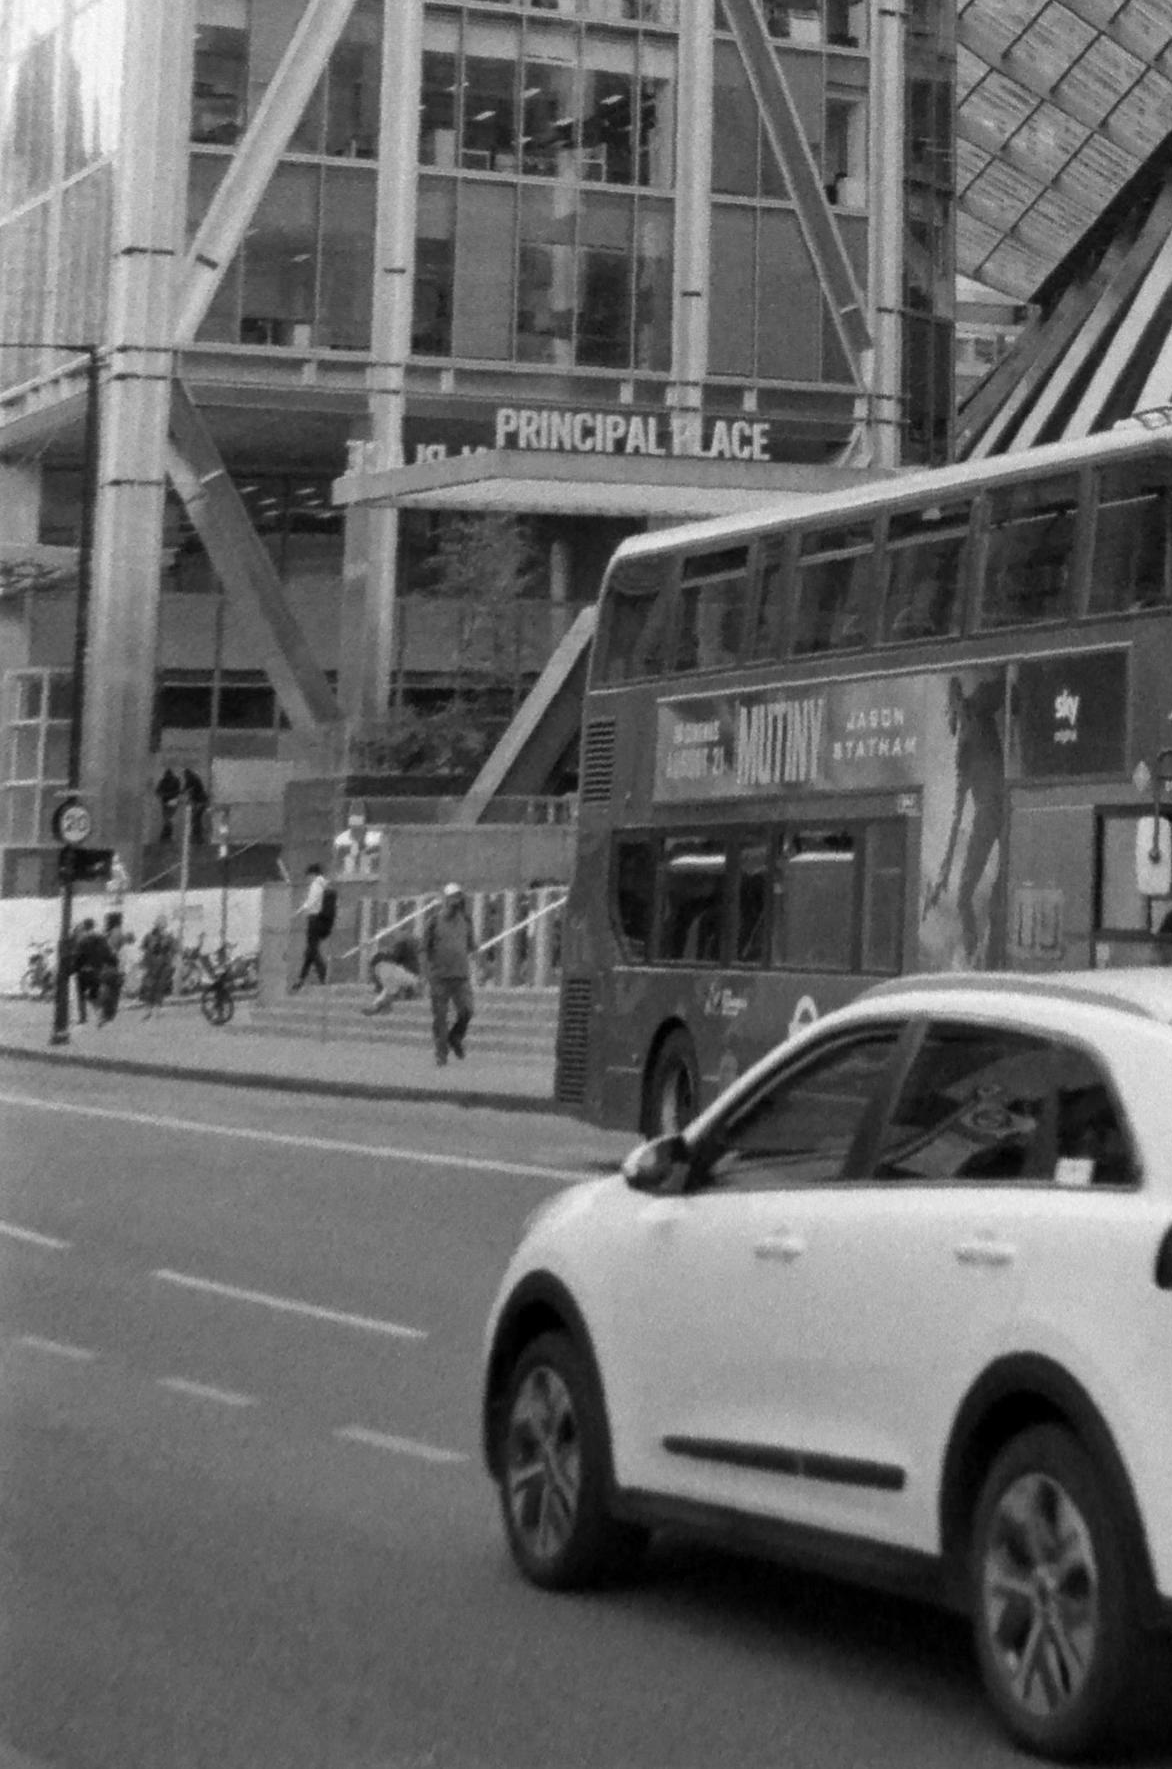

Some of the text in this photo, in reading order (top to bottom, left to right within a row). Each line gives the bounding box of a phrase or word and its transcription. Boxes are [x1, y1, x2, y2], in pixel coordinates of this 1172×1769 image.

[497, 407, 771, 462] PRINCIPAL PLACE
[846, 707, 904, 731] JASON
[1054, 689, 1079, 726] sky
[736, 697, 826, 785] MUTINY
[833, 736, 917, 761] STATHAM
